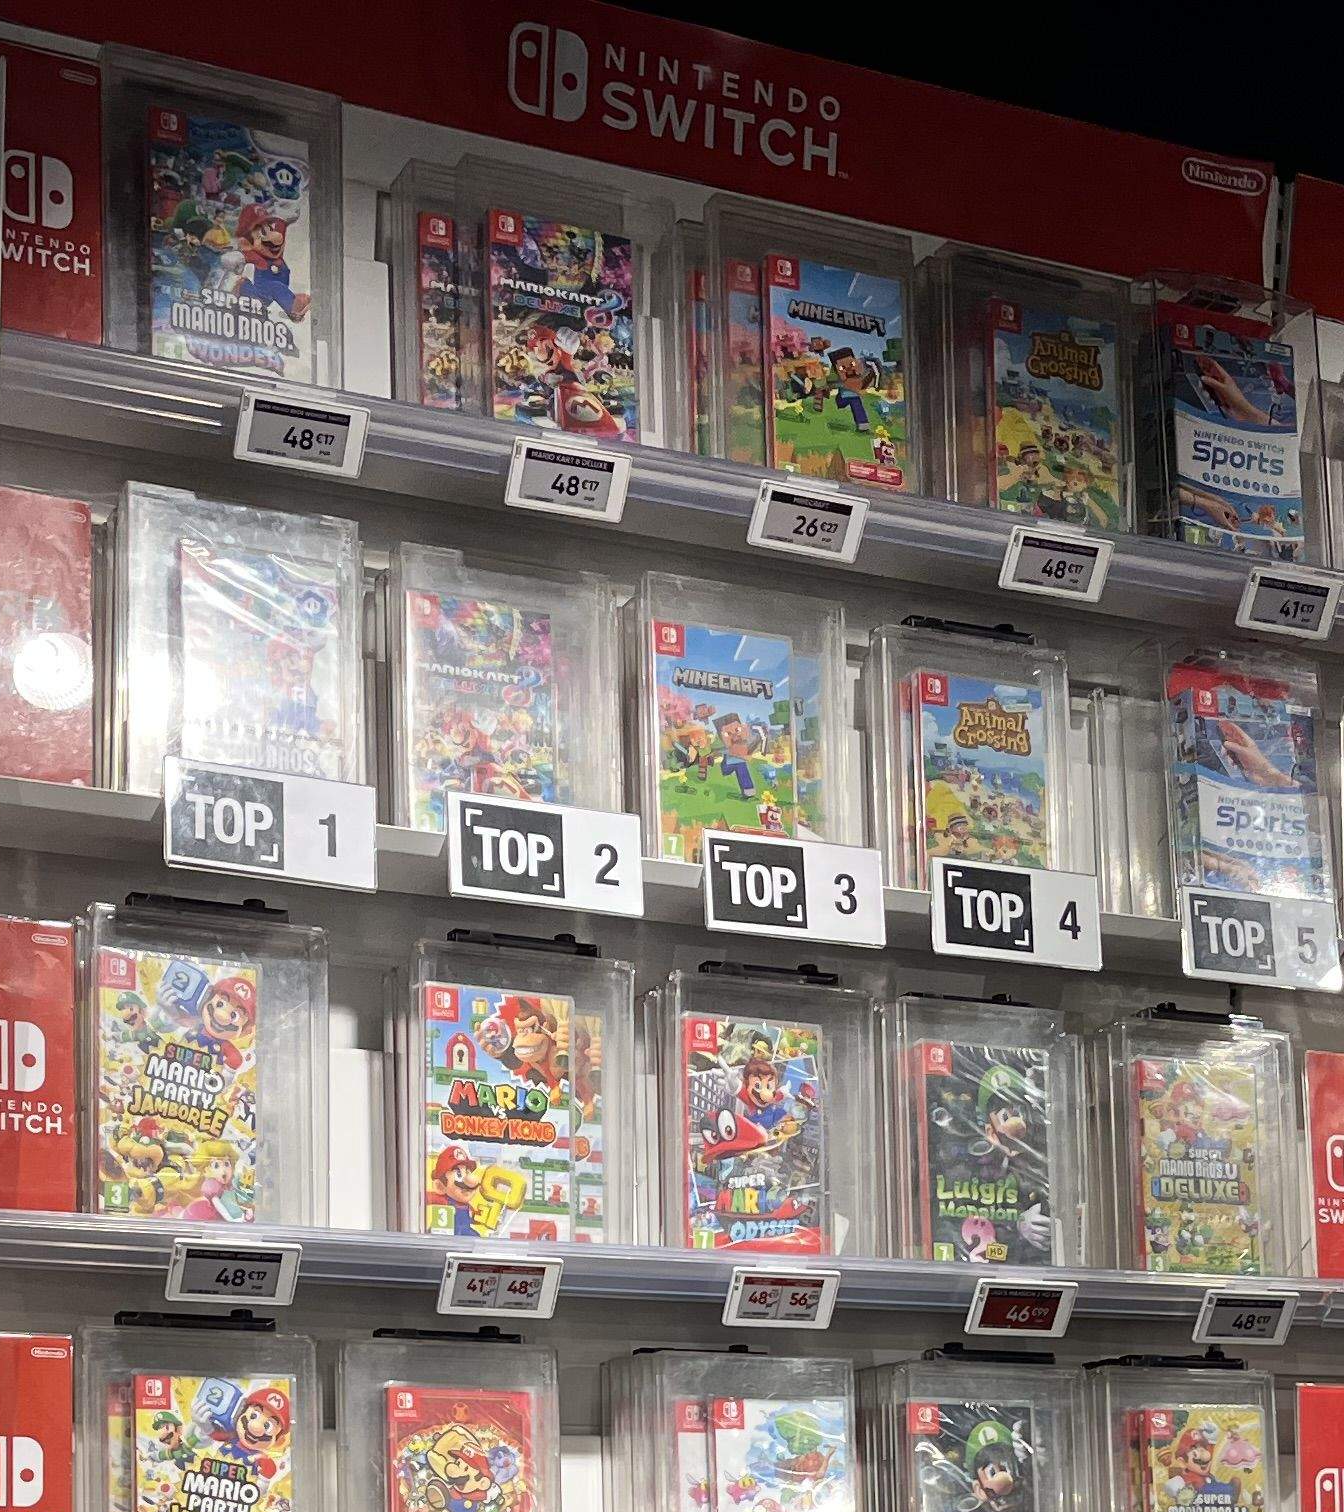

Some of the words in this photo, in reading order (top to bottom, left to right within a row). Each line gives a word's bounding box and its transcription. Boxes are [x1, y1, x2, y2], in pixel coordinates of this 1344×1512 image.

[606, 45, 840, 120] NINTENDO
[603, 82, 840, 177] SWITCH
[1189, 163, 1257, 191] Nintendo
[201, 288, 263, 316] SUPER
[788, 298, 888, 336] MINECRAFT
[172, 302, 234, 337] MARIO
[1031, 333, 1100, 366] Animal
[1027, 357, 1102, 389] Crossing
[1192, 440, 1285, 477] Sports
[673, 664, 774, 700] MINECRAFT
[959, 704, 1022, 732] Animal
[953, 723, 1031, 755] Crossing
[189, 791, 274, 848] TOP
[319, 813, 339, 858] 1
[472, 824, 555, 878] TOP
[594, 842, 620, 888] 2
[721, 860, 799, 911] TOP
[833, 872, 857, 915] 3
[954, 886, 1025, 935] TOP
[1058, 899, 1081, 941] 4
[1200, 913, 1266, 960] TOP
[1296, 925, 1318, 966] 5
[164, 1043, 212, 1069] SUPER
[147, 1056, 222, 1094] MARIO
[150, 1077, 213, 1109] PARTY
[450, 1080, 548, 1116] MARIO
[130, 1091, 227, 1138] JAMBOREE
[441, 1113, 504, 1140] DONKEY
[506, 1119, 556, 1144] KONG
[110, 1181, 124, 1205] 3
[1159, 1179, 1240, 1201] DELUXE
[436, 1207, 450, 1229] 3
[938, 1201, 1017, 1220] Mansion
[200, 1458, 248, 1480] SUPER
[182, 1472, 259, 1505] MARIO
[1200, 1493, 1232, 1505] SUPER
